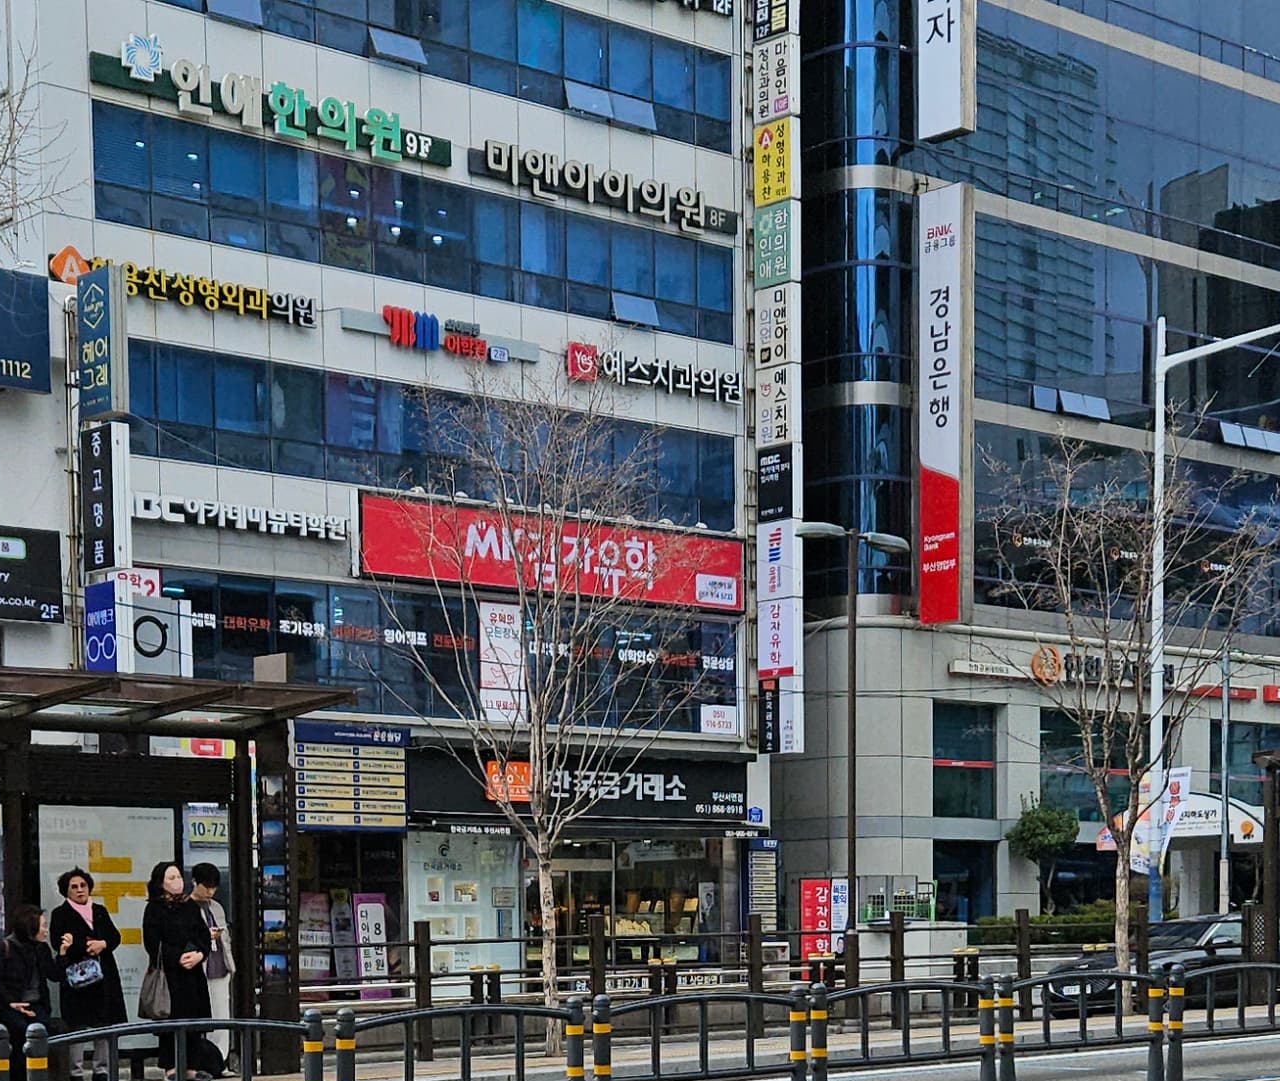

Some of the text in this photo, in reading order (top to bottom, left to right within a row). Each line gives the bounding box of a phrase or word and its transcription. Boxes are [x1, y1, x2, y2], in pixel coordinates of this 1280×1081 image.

[758, 48, 770, 119] 정신과의원
[775, 41, 788, 95] 마음인
[405, 133, 432, 158] 9F
[775, 123, 786, 185] 성형외과
[486, 139, 726, 232] 미앤아이의원 8F
[759, 238, 772, 279] 인애
[773, 209, 788, 278] 한의원
[927, 222, 953, 240] BNK
[82, 335, 108, 364] 헤어
[444, 333, 488, 362] 어학원
[773, 288, 788, 361] 미앤아이
[603, 348, 743, 406] 예스치과의원
[929, 286, 952, 428] 경남은행
[774, 367, 789, 441] 예스치과
[92, 431, 105, 566] 중고명품
[131, 491, 348, 541] BC아카데미뷰티학원
[40, 603, 59, 620] 2F
[769, 604, 781, 665] 감자유학
[190, 821, 228, 838] 10-72
[695, 802, 711, 815] 051)
